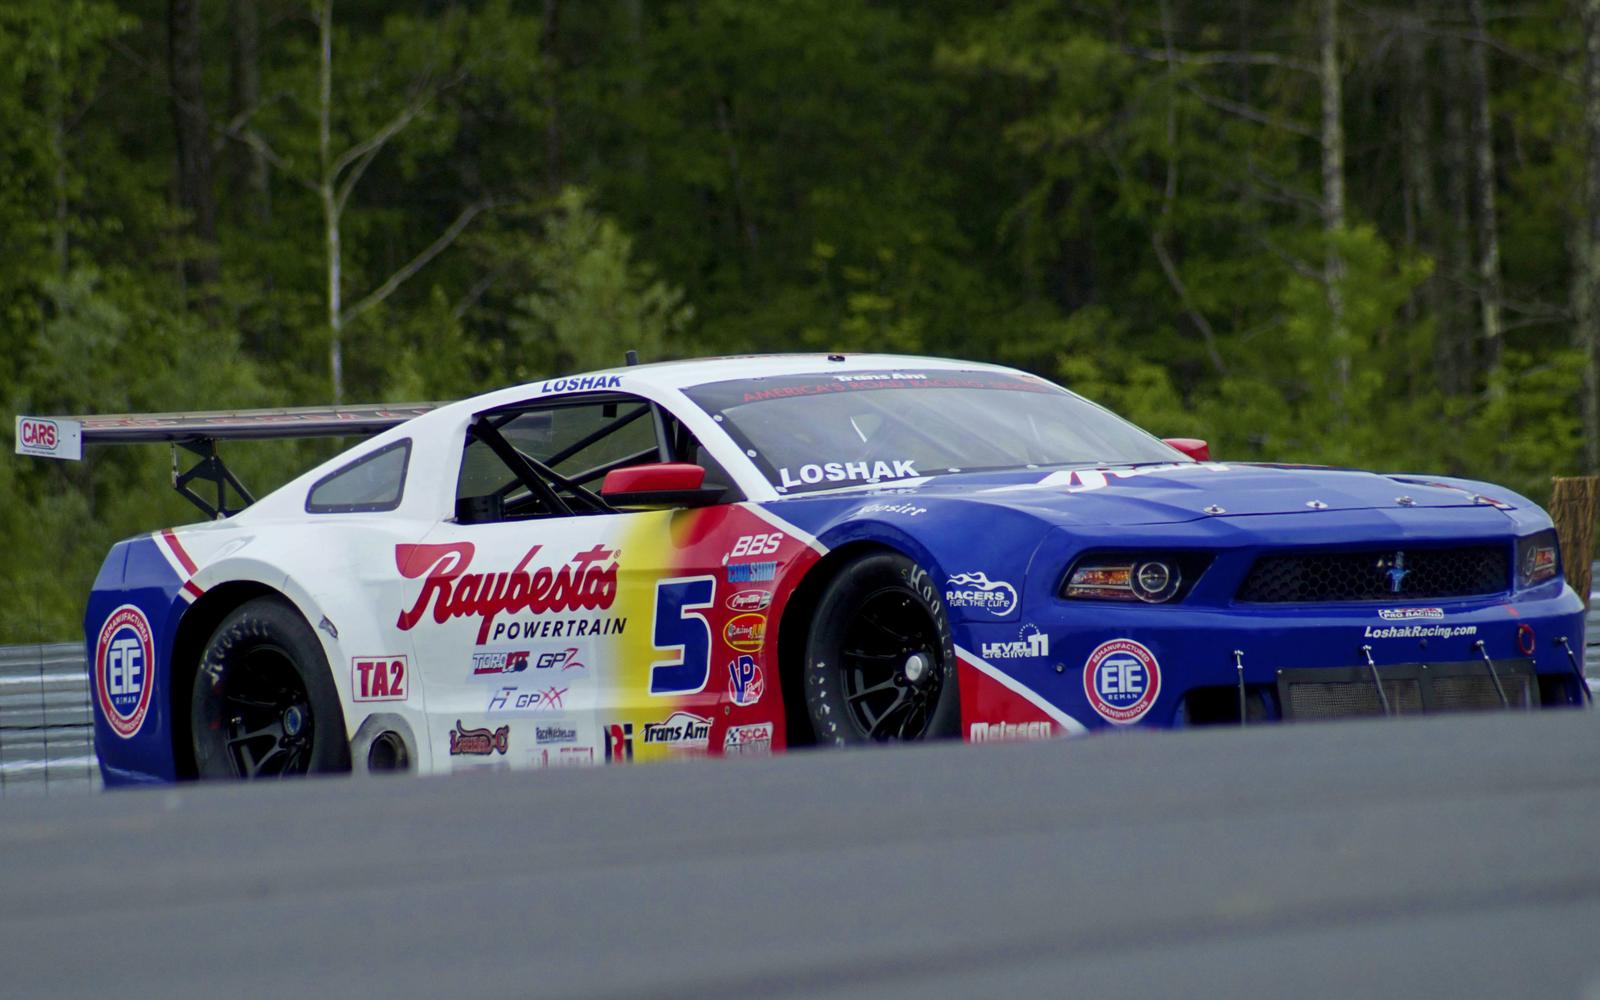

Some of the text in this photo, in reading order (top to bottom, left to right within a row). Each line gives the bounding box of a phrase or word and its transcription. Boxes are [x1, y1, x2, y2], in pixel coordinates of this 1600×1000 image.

[541, 375, 623, 394] LOSHAK
[22, 421, 56, 447] CARS
[779, 459, 921, 488] LOSHAK
[730, 532, 783, 558] BBS
[395, 541, 619, 646] Raybestos
[946, 590, 1005, 601] RACERS
[949, 599, 969, 607] FUEL
[969, 599, 987, 607] THE
[1406, 610, 1442, 618] RACING
[492, 617, 627, 641] POWERTRAIN
[649, 574, 716, 697] 5
[1364, 625, 1476, 638] LoshakRacing.com
[1092, 640, 1151, 663] REMANUFACTURED
[109, 638, 142, 695] ETE
[1101, 659, 1143, 694] ETE
[357, 661, 405, 697] TA2
[728, 654, 756, 704] VP
[1108, 692, 1139, 701] REMAN
[1097, 700, 1150, 720] TRANSMISSIONS
[644, 720, 709, 743] Trans Am
[739, 727, 769, 743] SCCA
